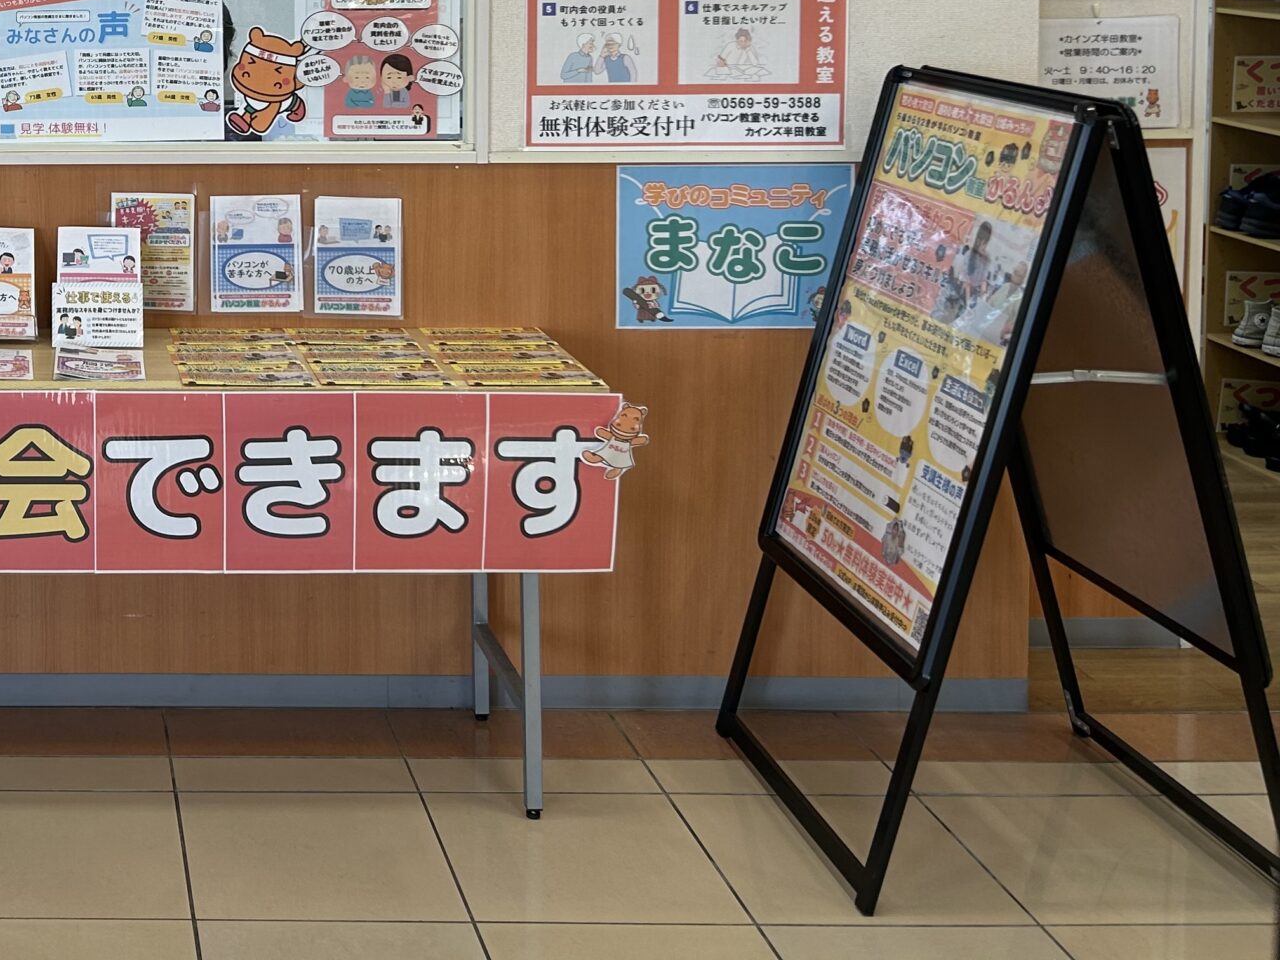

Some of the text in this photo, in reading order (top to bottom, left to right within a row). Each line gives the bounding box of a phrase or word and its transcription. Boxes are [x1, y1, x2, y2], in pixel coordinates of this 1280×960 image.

[559, 4, 627, 15] 町内会の役員が
[702, 1, 788, 13] 仕事でスキルアップ
[6, 10, 131, 45] みなさんの声
[560, 16, 645, 28] もうすぐ回ってくる
[548, 98, 686, 112] お気軽にご参加ください
[721, 96, 822, 110] 0569-59-3588
[701, 112, 820, 124] パソコン教室やればできる
[538, 115, 696, 138] 無料体験受付中
[744, 125, 827, 138] カインズ半田教室
[883, 127, 977, 194] パソコン
[642, 181, 828, 210] 学びのコミュニティ
[644, 213, 827, 285] まなこ
[227, 260, 269, 269] パソコンが
[328, 265, 375, 277] 70歳以上
[227, 269, 273, 280] 苦手な方へ
[346, 276, 374, 286] の方へ
[64, 290, 133, 305] 仕事で使える
[846, 327, 868, 348] Word
[896, 352, 921, 375] Excel
